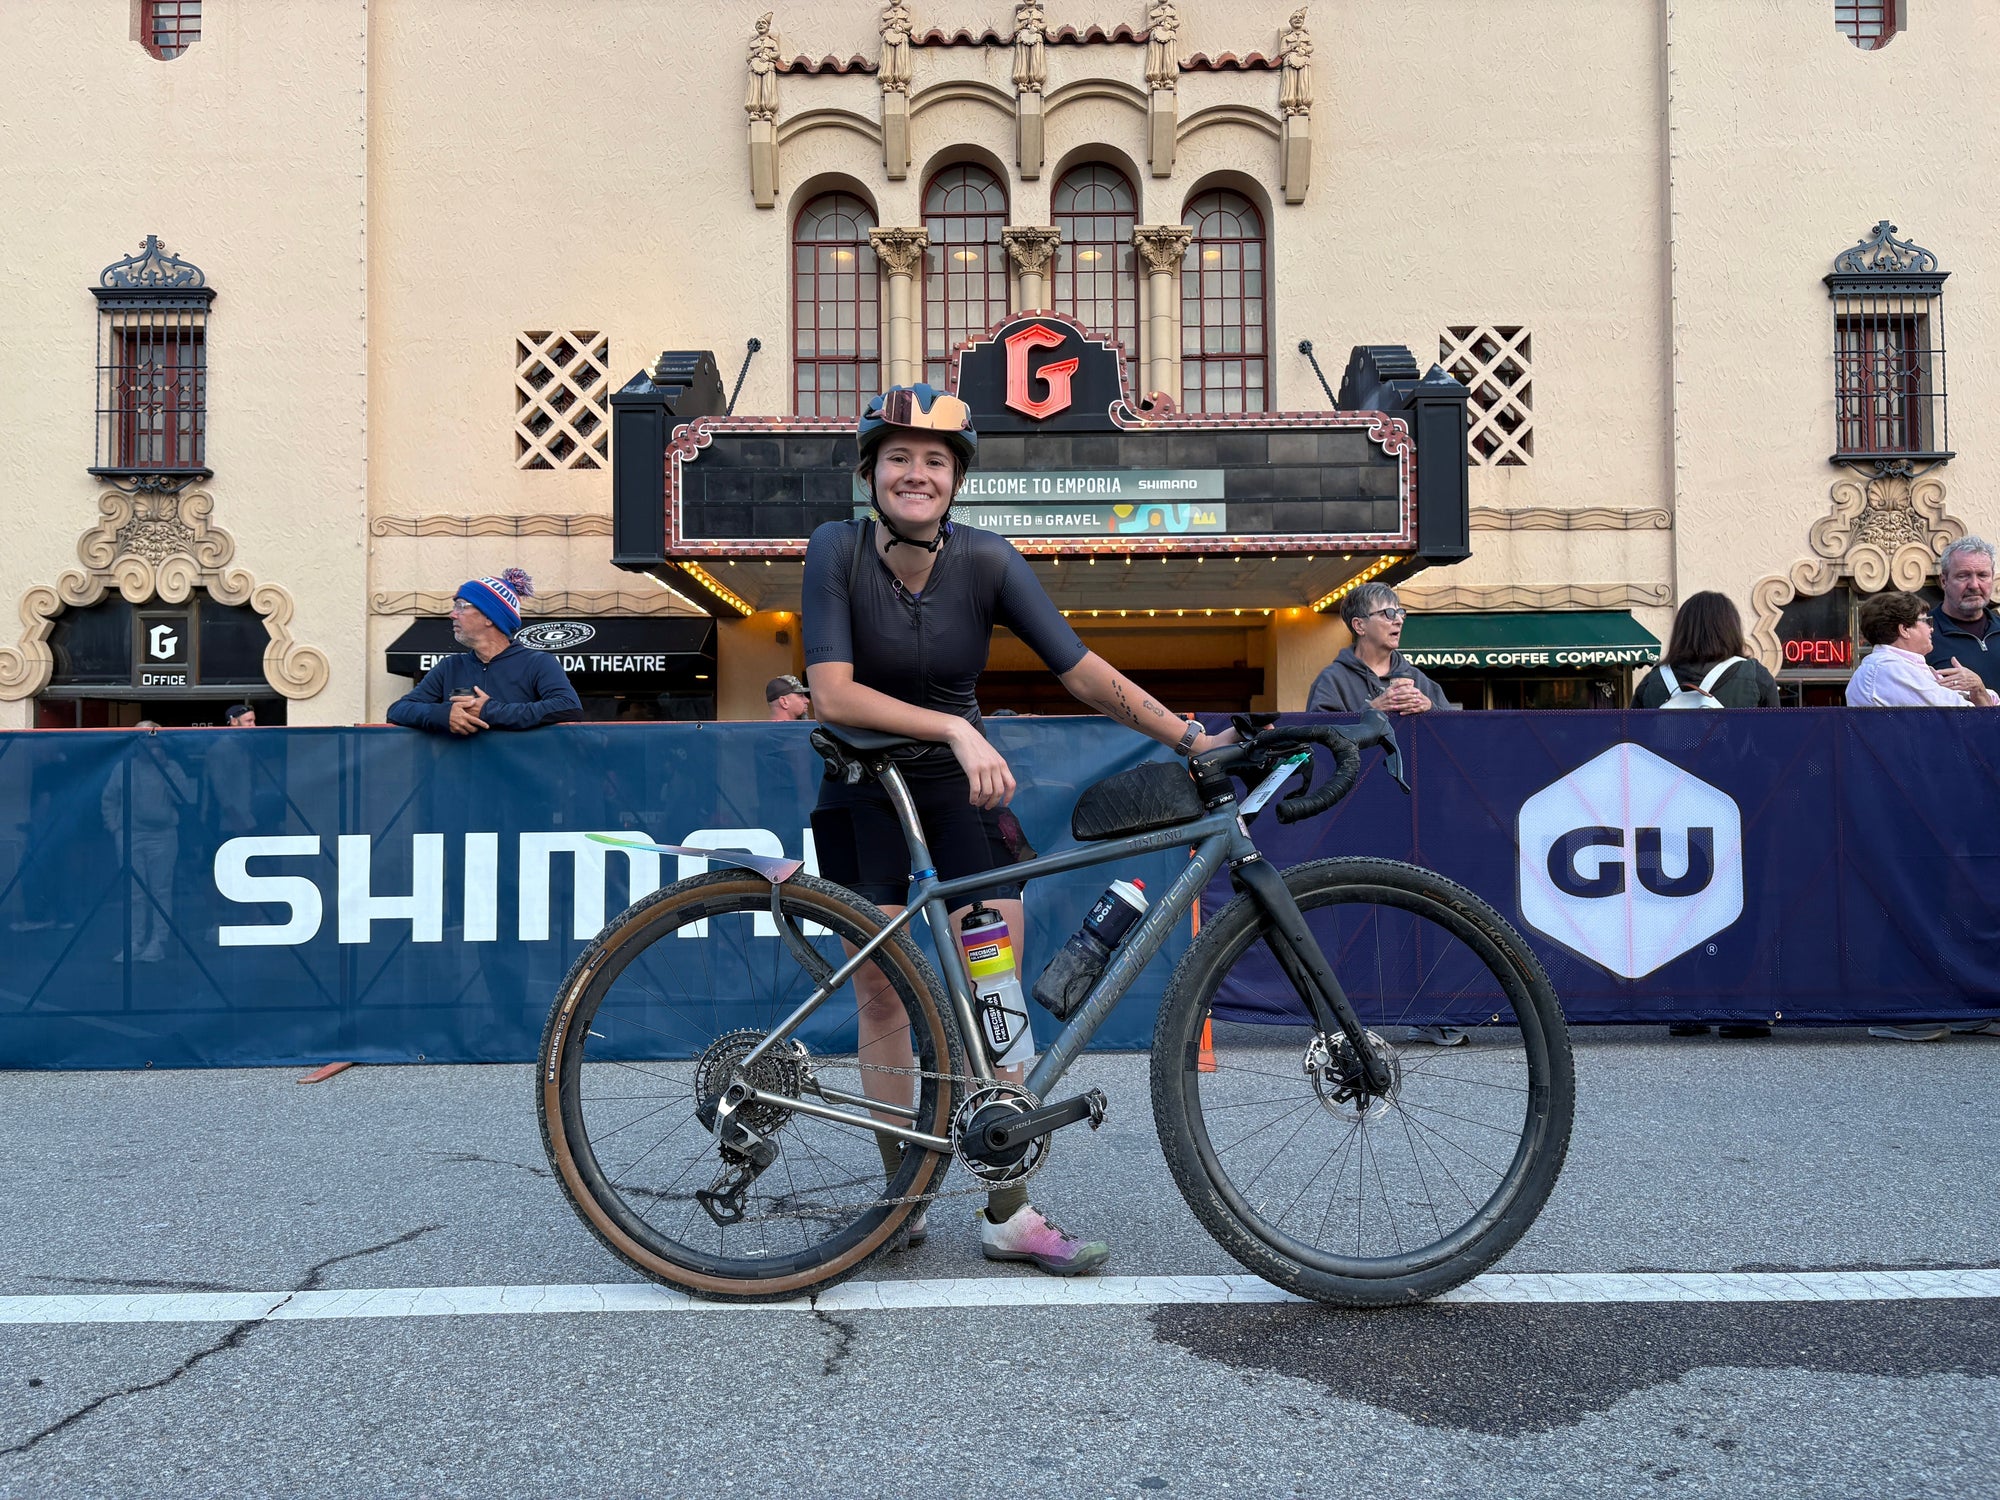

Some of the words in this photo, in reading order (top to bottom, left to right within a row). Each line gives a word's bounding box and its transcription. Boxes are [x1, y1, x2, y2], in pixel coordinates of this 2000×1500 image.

[1004, 323, 1080, 419] G
[1033, 478, 1051, 494] TO
[1057, 477, 1122, 494] EMPORIA
[1138, 479, 1198, 490] SHIMANO
[978, 515, 1031, 526] UNITED
[1045, 514, 1101, 526] GRAVEL
[150, 624, 178, 659] G
[1785, 640, 1844, 662] OPEN
[590, 655, 666, 672] THEATRE
[1403, 653, 1479, 665] RANADA
[1485, 652, 1549, 665] COFFEE
[1555, 650, 1643, 664] COMPANY
[1547, 826, 1714, 899] GU
[214, 828, 934, 946] SHIMA
